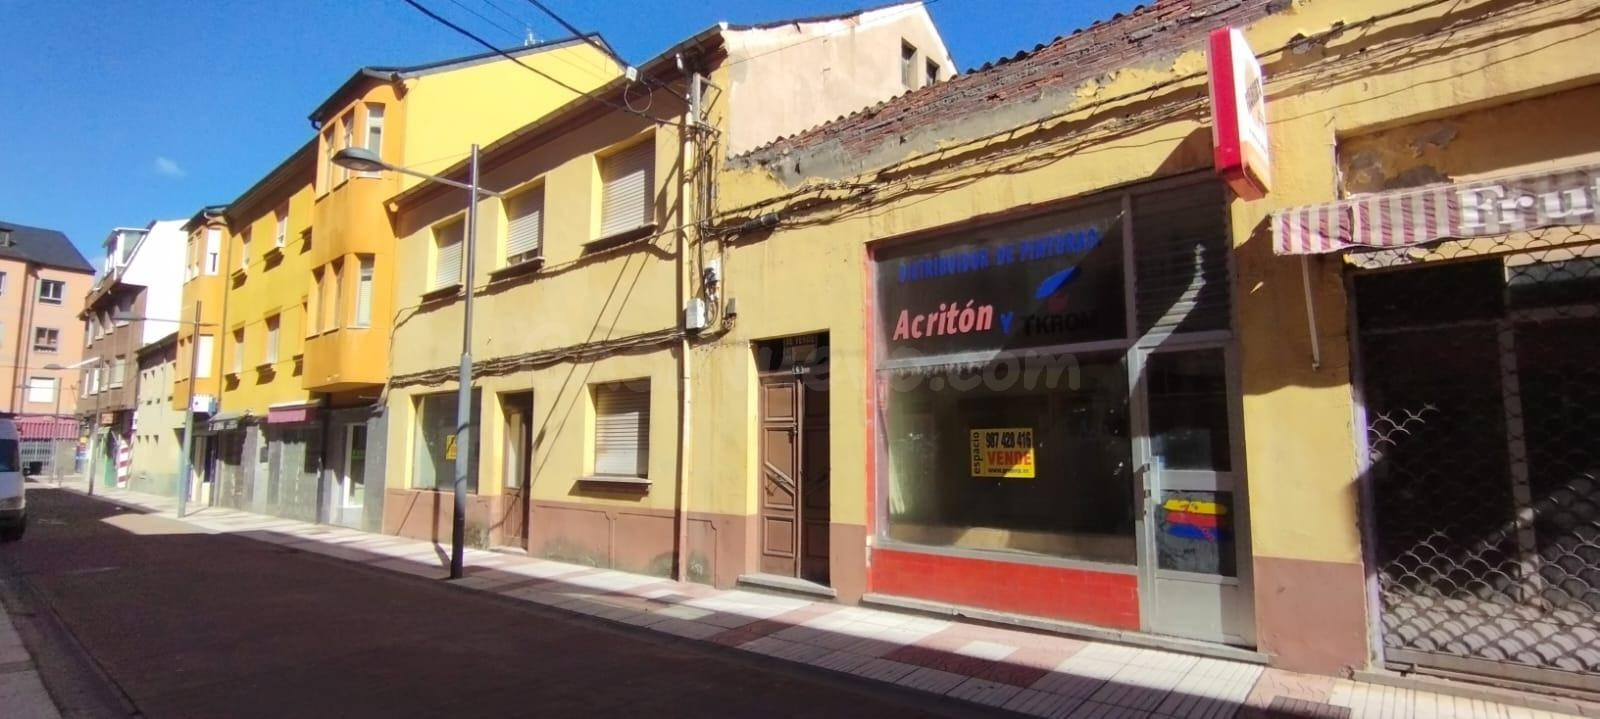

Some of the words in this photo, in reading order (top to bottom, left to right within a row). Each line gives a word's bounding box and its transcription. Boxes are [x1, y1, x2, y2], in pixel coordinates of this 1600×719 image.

[996, 244, 1014, 265] DE
[892, 299, 994, 341] Acritón
[985, 431, 1000, 449] 987
[1017, 431, 1032, 448] 416
[973, 432, 983, 474] espacio
[987, 451, 1032, 466] VENDE
